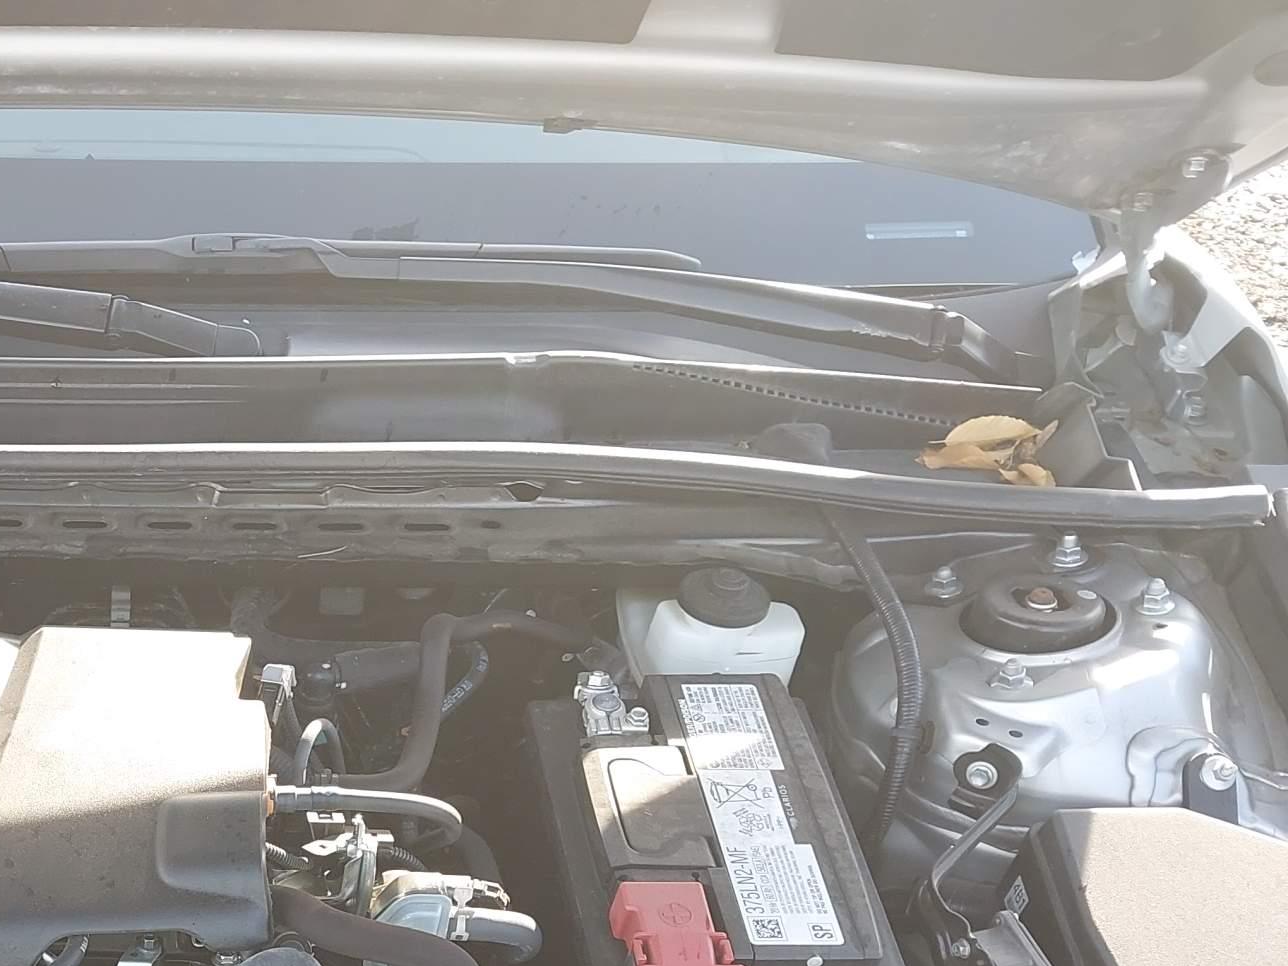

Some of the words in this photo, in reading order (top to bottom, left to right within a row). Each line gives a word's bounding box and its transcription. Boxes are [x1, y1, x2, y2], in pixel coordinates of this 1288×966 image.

[762, 786, 775, 799] Pb
[779, 784, 795, 817] CLARIOS
[726, 846, 765, 914] 375LN2-MF
[812, 924, 833, 939] SP
